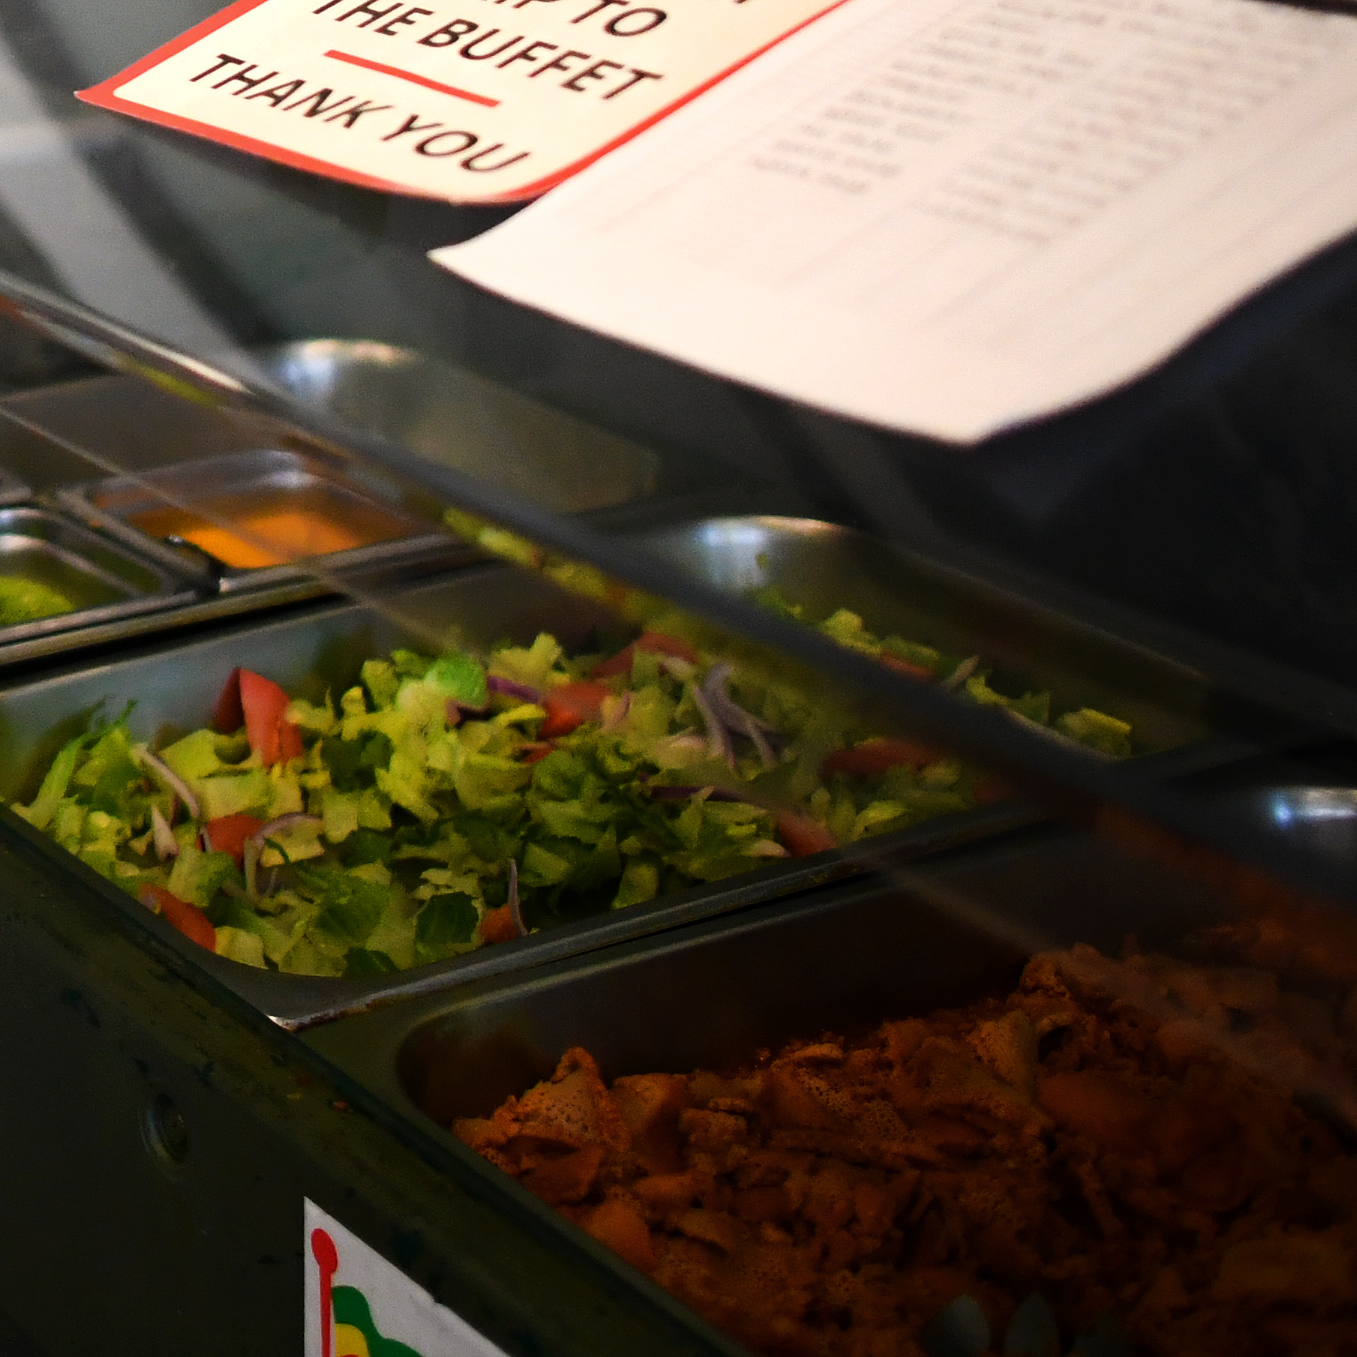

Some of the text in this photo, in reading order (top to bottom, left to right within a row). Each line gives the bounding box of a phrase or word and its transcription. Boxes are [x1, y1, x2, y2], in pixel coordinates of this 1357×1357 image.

[419, 18, 663, 101] BUFFET
[190, 53, 531, 175] THANK YOU
